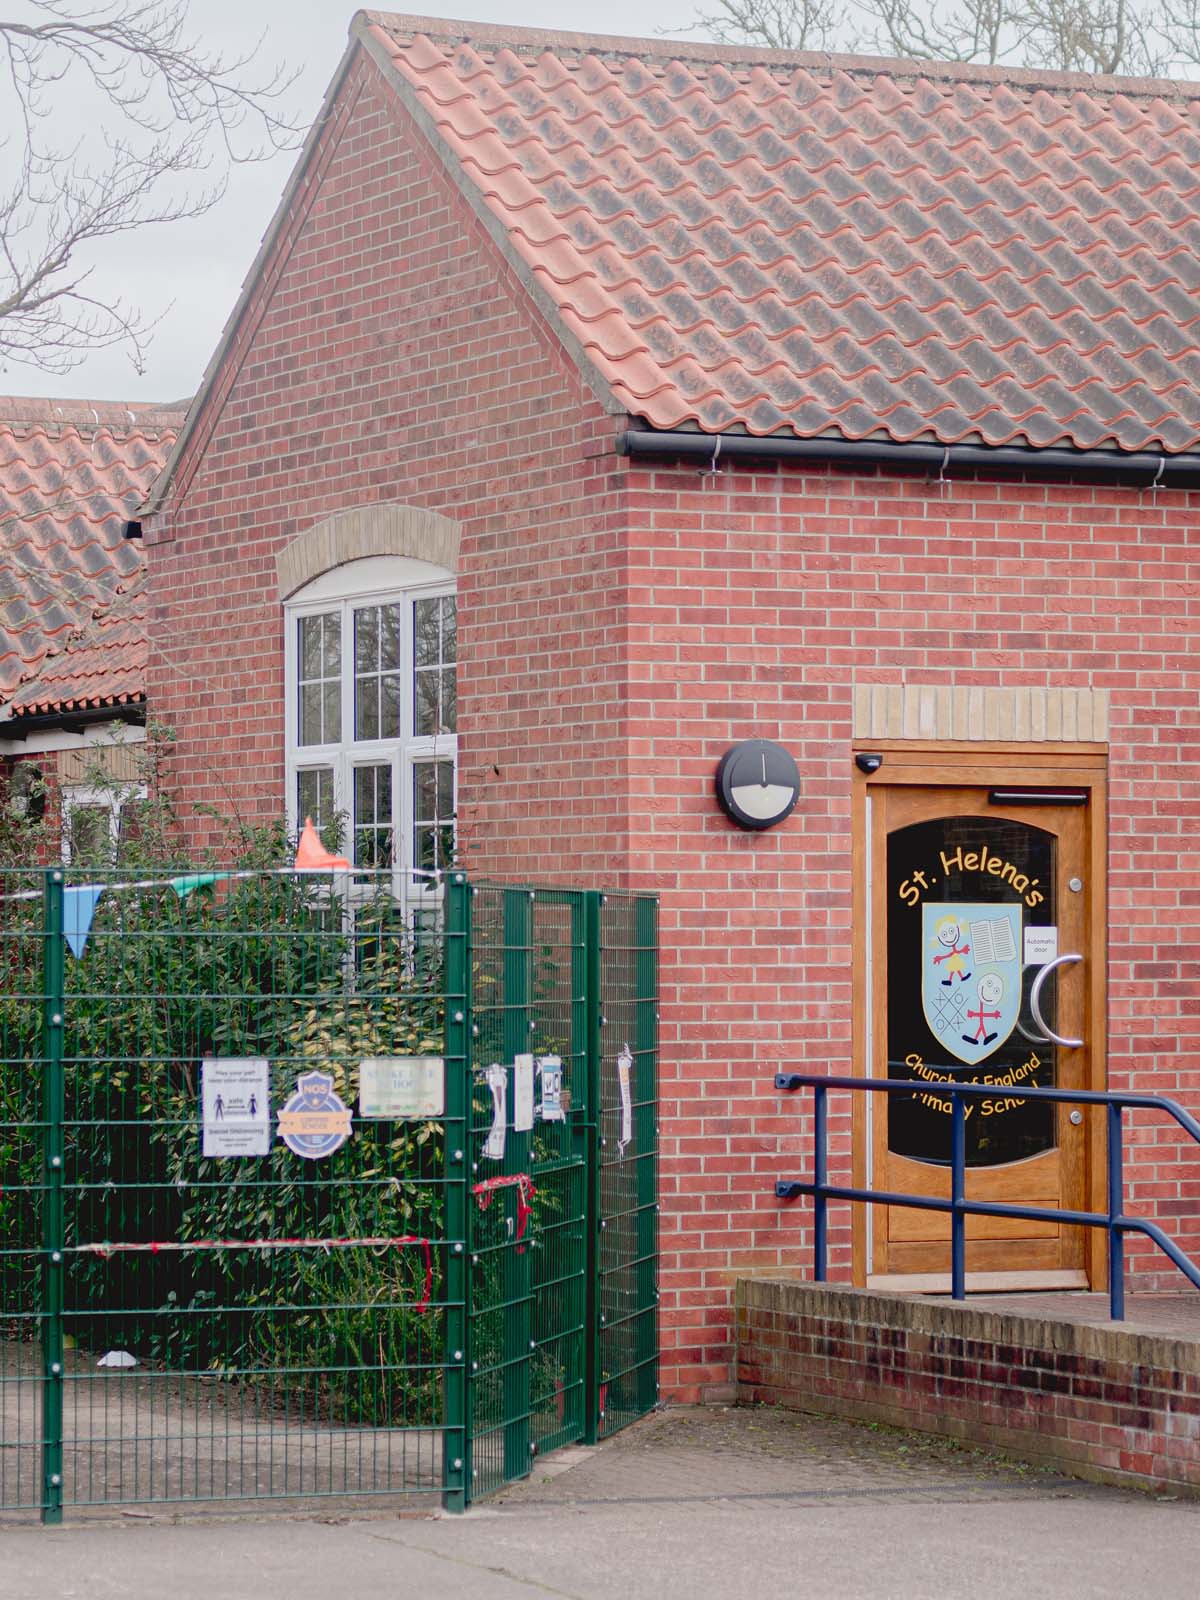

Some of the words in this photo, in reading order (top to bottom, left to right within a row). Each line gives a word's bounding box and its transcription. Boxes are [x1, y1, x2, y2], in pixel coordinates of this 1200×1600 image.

[898, 869, 937, 907] St.
[939, 845, 1045, 907] Helena's
[1026, 937, 1056, 945] Automatic
[904, 1053, 957, 1083] Church
[983, 1051, 1041, 1087] England
[303, 1084, 328, 1094] NOS
